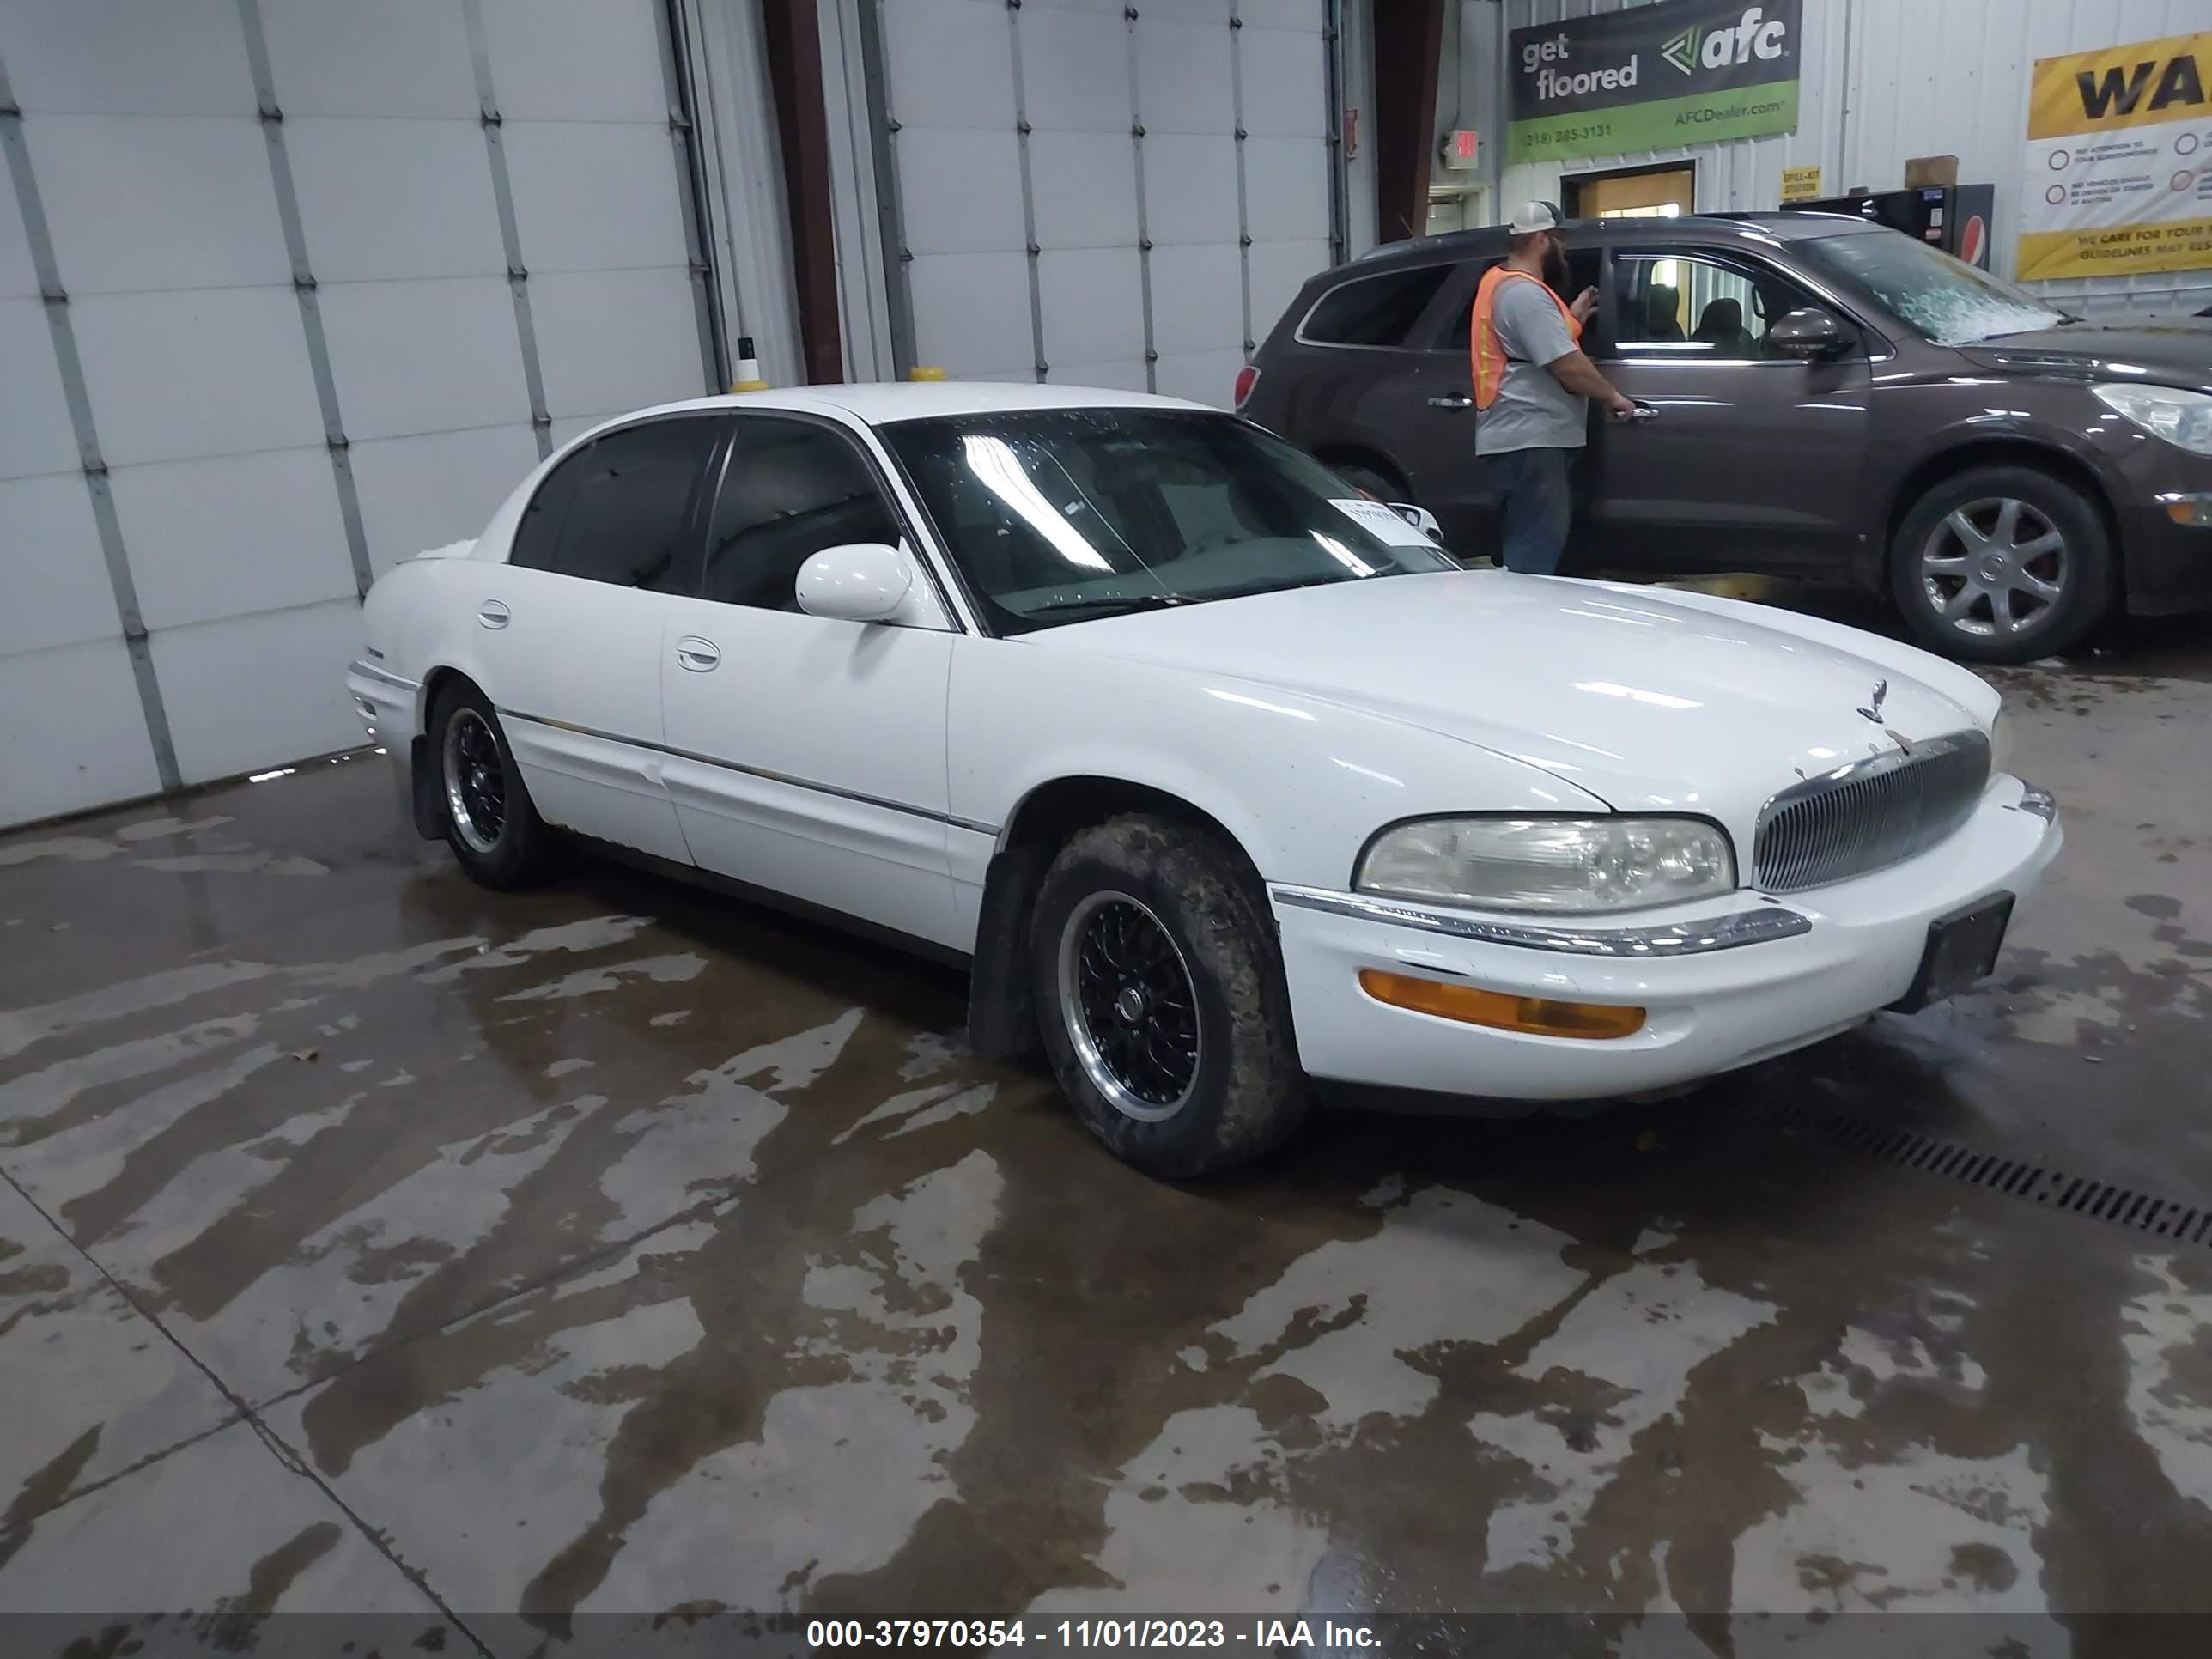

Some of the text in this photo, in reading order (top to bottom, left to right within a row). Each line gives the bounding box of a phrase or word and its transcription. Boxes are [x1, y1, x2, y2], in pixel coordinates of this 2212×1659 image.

[1522, 33, 1570, 73] get
[1701, 8, 1786, 69] afc
[1536, 55, 1638, 100] floored
[2075, 55, 2212, 119] WA
[1674, 103, 1781, 125] AFCDealer.com
[2078, 235, 2097, 246] WE
[2100, 233, 2131, 245] CARE
[2136, 229, 2161, 241] FOR
[2166, 226, 2203, 238] YOUR
[2081, 246, 2152, 260] GUIDELINES
